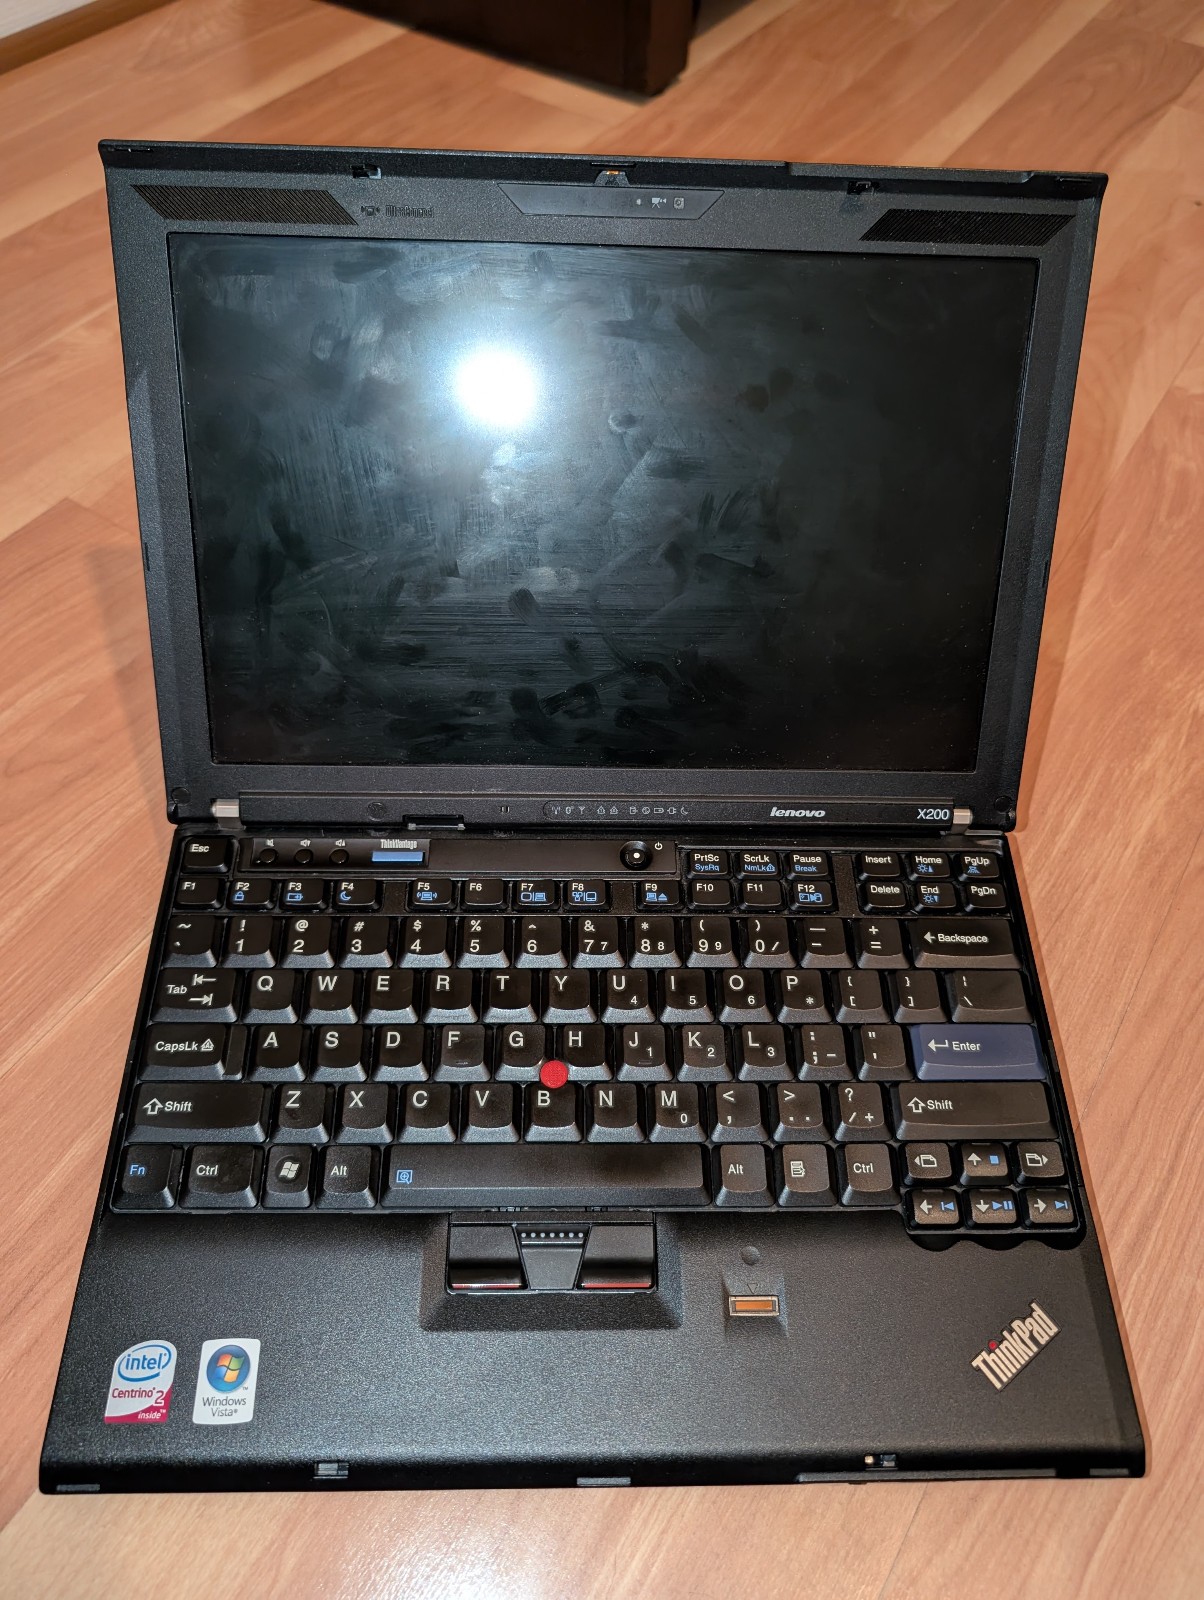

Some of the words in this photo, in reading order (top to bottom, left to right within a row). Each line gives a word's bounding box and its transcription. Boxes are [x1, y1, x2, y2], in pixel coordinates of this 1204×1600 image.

[770, 807, 825, 818] lenovo
[917, 809, 949, 820] X200
[190, 844, 210, 852] Esc
[380, 839, 418, 849] ThinkVantage
[694, 854, 719, 862] PrtSc
[744, 854, 769, 862] ScrLk
[964, 857, 989, 866] PgUp
[744, 864, 766, 872] NmLk
[184, 882, 196, 890] F1
[237, 882, 249, 890] F2
[289, 882, 302, 890] F3
[341, 882, 354, 890] F4
[418, 882, 430, 890] F5
[470, 883, 482, 891] F6
[522, 883, 533, 891] F7
[572, 883, 584, 891] F8
[798, 884, 815, 892] F12
[871, 885, 900, 893] Delete
[921, 886, 939, 894] End
[971, 886, 996, 896] PgDn
[240, 920, 246, 931] !
[296, 920, 308, 931] @
[354, 922, 364, 931] #
[413, 920, 421, 931] $
[471, 920, 481, 931] %
[584, 920, 595, 931] &
[755, 920, 760, 931] )
[869, 926, 878, 934] +
[938, 934, 988, 944] Backspace
[236, 939, 244, 952] 1
[293, 940, 304, 952] 2
[351, 940, 361, 952] 3
[411, 940, 421, 952] 4
[470, 940, 479, 952] 5
[527, 940, 537, 952] 6
[584, 940, 594, 952] 7
[601, 942, 607, 950] 7
[641, 940, 650, 952] 8
[658, 942, 664, 950] 8
[699, 939, 708, 952] 9
[715, 942, 722, 950] 9
[756, 940, 765, 952] 0
[772, 942, 779, 950] /
[258, 976, 273, 991] Q
[319, 976, 337, 990] W
[377, 976, 390, 990] E
[437, 975, 450, 991] R
[497, 976, 509, 991] T
[555, 976, 567, 990] Y
[613, 975, 626, 990] U
[729, 975, 744, 990] O
[787, 976, 798, 990] P
[168, 985, 187, 994] Tab
[631, 996, 637, 1004] 4
[690, 996, 696, 1005] 5
[748, 996, 755, 1004] 6
[263, 1032, 278, 1047] A
[325, 1032, 338, 1047] S
[386, 1032, 400, 1046] D
[448, 1031, 460, 1047] F
[509, 1031, 523, 1046] G
[569, 1031, 582, 1047] H
[629, 1032, 638, 1047] J
[688, 1032, 701, 1046] K
[748, 1031, 759, 1046] L
[156, 1041, 198, 1052] CapsLk
[647, 1047, 652, 1056] 1
[768, 1047, 774, 1056] 3
[952, 1042, 980, 1050] Enter
[708, 1048, 714, 1057] 2
[286, 1091, 300, 1107] Z
[349, 1091, 364, 1108] X
[413, 1091, 428, 1108] C
[476, 1091, 489, 1106] V
[538, 1091, 550, 1106] B
[600, 1090, 612, 1106] N
[661, 1091, 676, 1106] M
[722, 1091, 734, 1101] <
[784, 1090, 795, 1100] >
[845, 1088, 853, 1101] ?
[165, 1102, 192, 1112] Shift
[927, 1100, 954, 1110] Shift
[865, 1113, 873, 1122] +
[130, 1165, 145, 1176] Fn
[196, 1165, 218, 1175] Ctrl
[331, 1166, 347, 1176] Alt
[728, 1164, 743, 1174] Alt
[854, 1163, 874, 1173] Ctrl
[971, 1302, 1058, 1390] ThinkPad
[153, 1390, 164, 1406] 2
[202, 1396, 246, 1406] Windows
